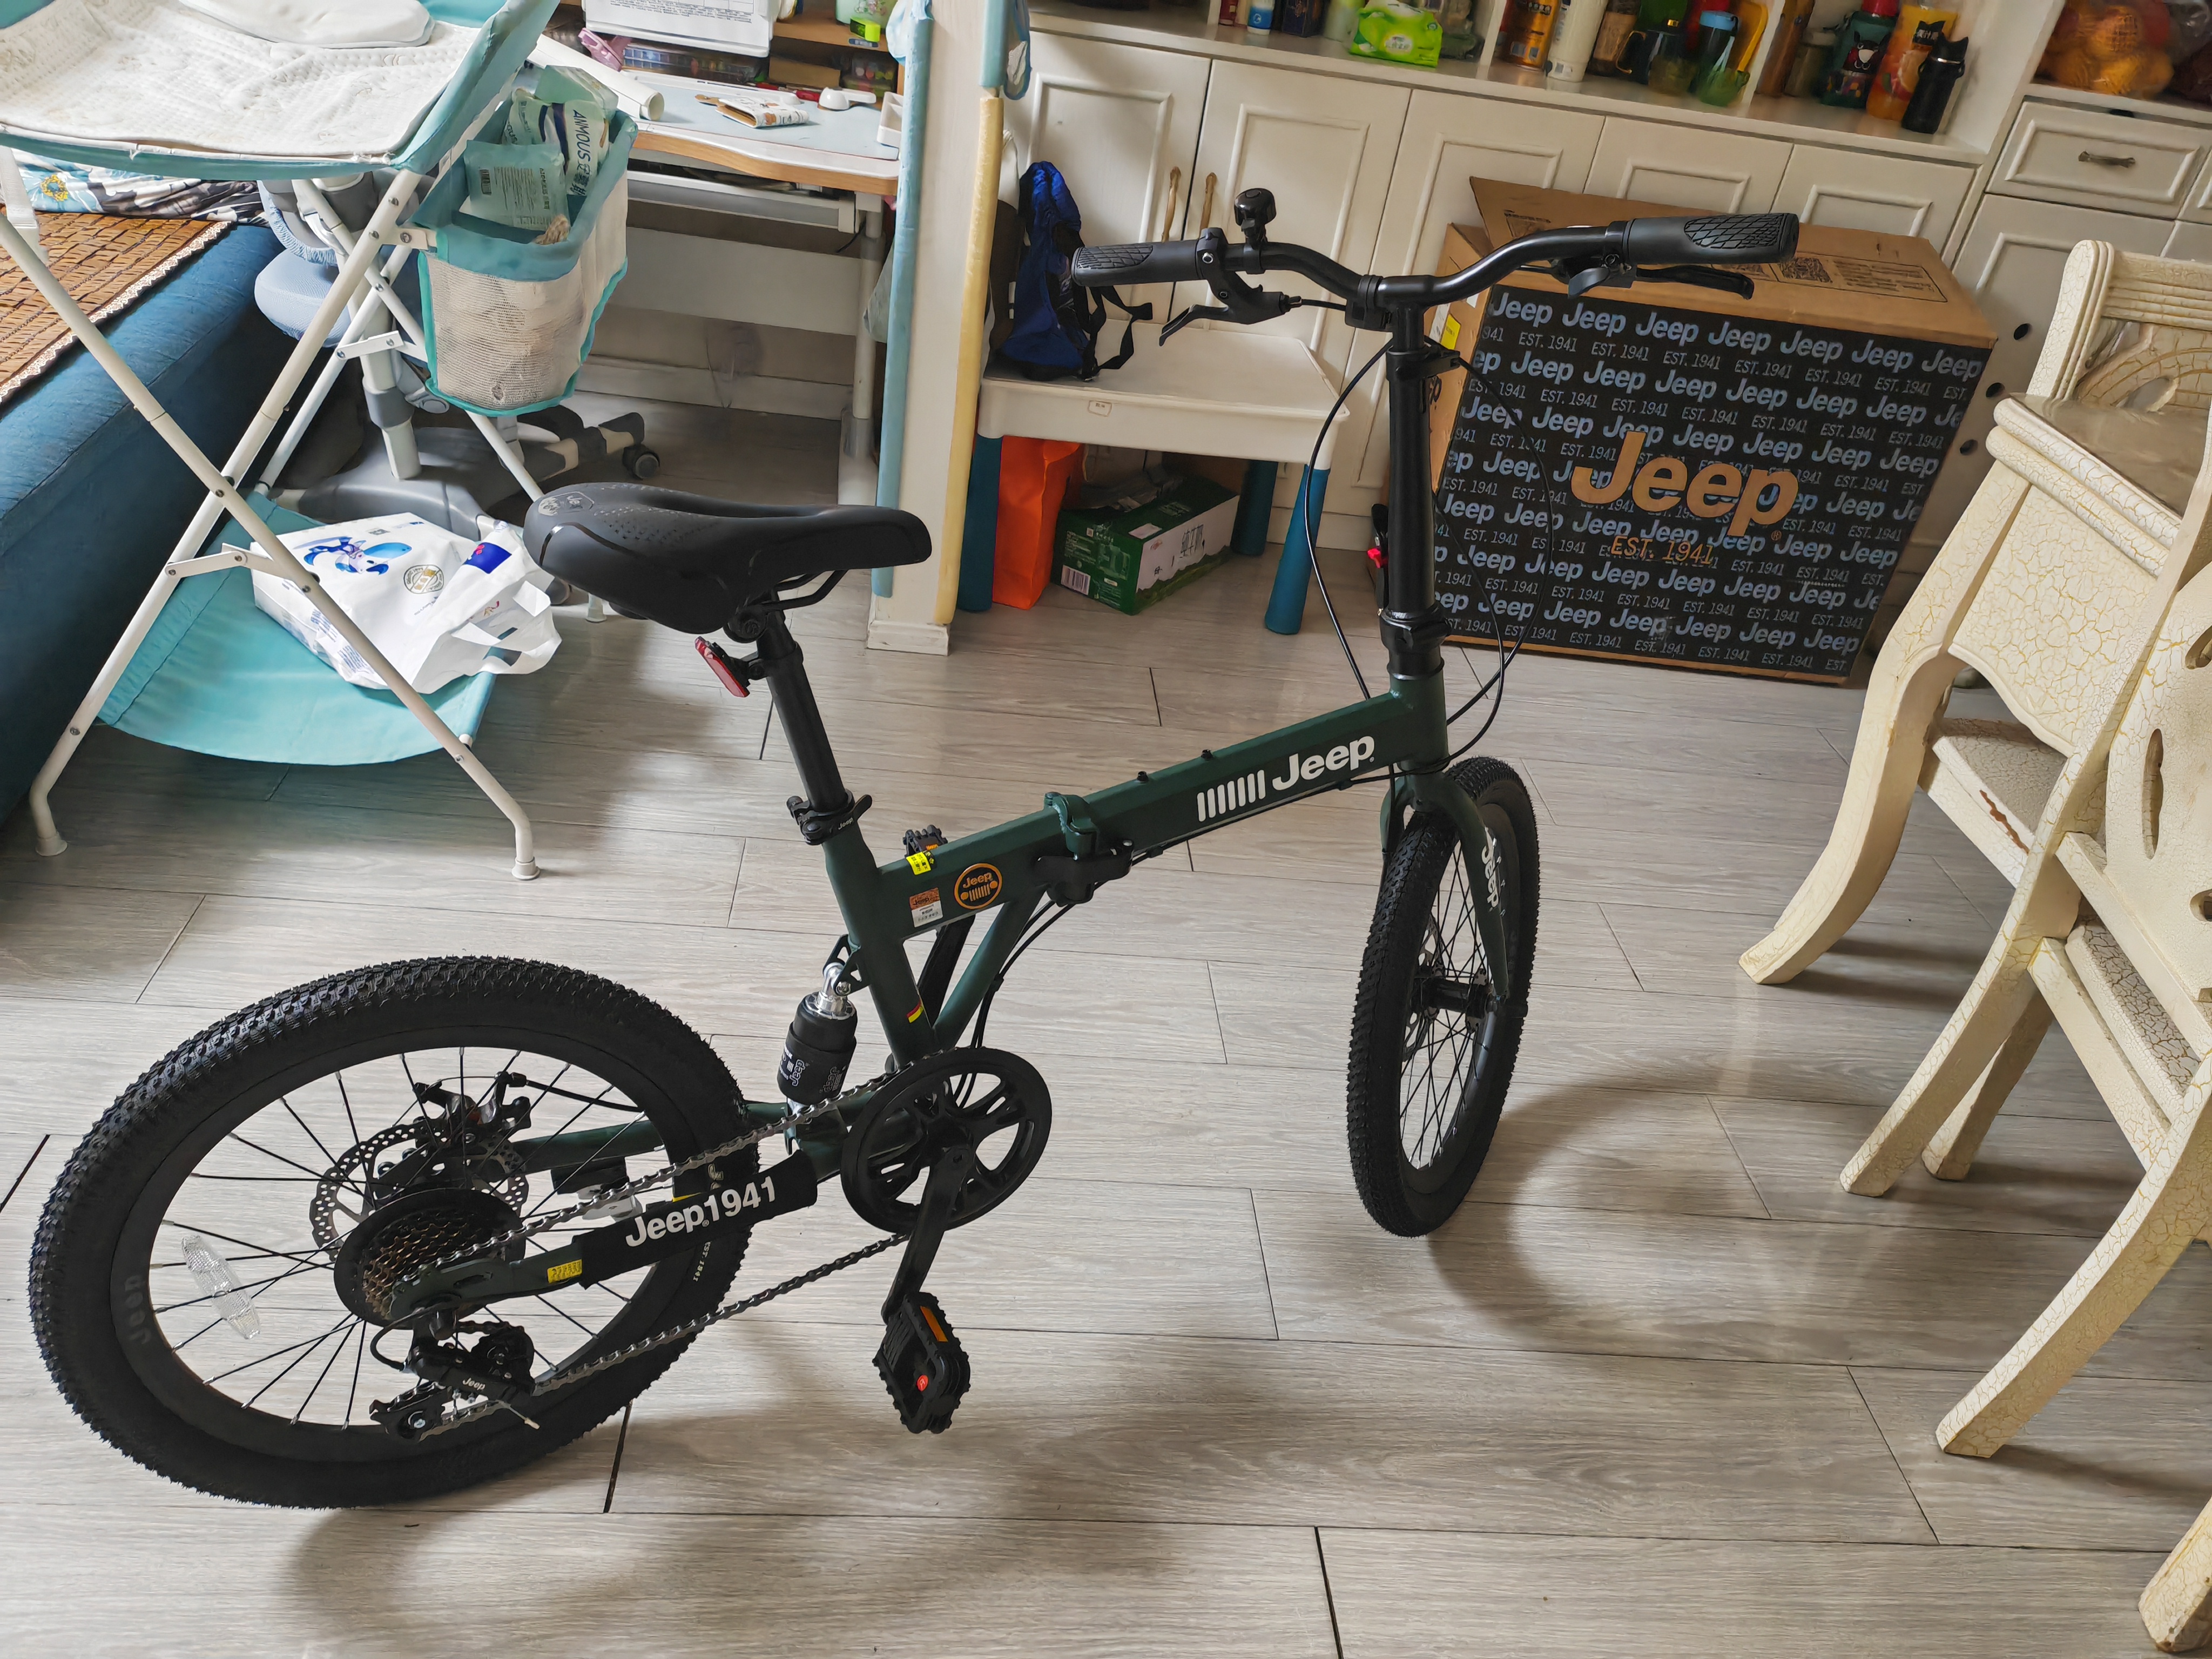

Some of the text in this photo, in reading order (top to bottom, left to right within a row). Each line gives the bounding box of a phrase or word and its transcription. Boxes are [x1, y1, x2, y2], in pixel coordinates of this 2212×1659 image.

[572, 109, 591, 162] ANMOUS
[1482, 327, 1503, 341] 941
[1519, 332, 1544, 347] EST.
[1548, 335, 1577, 352] 1941
[1591, 342, 1616, 358] EST.
[1620, 345, 1649, 361] 1941
[1663, 352, 1688, 366] EST.
[1692, 354, 1721, 370] 1941
[1735, 360, 1759, 374] EST.
[1763, 363, 1792, 379] 1941
[1805, 368, 1829, 382] EST.
[1833, 372, 1862, 387] 1941
[1874, 377, 1899, 392] EST.
[1903, 381, 1931, 396] 1941
[1489, 292, 1982, 381] Jeep Jeep Jeep Jeep Jeep Jeep Jeep
[1473, 350, 1961, 428] ep Jeep Jeep Jeep Jeep Jeep Jeep Je
[1499, 382, 1526, 399] 1941
[1540, 389, 1566, 404] EST.
[1569, 393, 1598, 409] 1941
[1611, 399, 1636, 413] EST.
[1640, 401, 1668, 417] 1941
[1682, 408, 1705, 422] EST.
[1709, 410, 1738, 425] 1941
[1751, 415, 1776, 429] EST.
[1779, 419, 1808, 433] 1941
[1820, 423, 1844, 437] EST.
[1848, 426, 1877, 442] 1941
[1889, 432, 1913, 446] EST.
[1916, 434, 1944, 449] 1941
[1454, 428, 1476, 443] 941
[1490, 433, 1514, 449] EST.
[1518, 436, 1546, 453] 141
[1560, 443, 1584, 458] EST.
[1588, 446, 1616, 461] 1941
[1835, 475, 1860, 488] EST.
[1862, 477, 1890, 492] 1941
[1461, 396, 1523, 429] Jeep
[1532, 407, 1594, 438] Jeep
[1673, 424, 1734, 456] Jeep
[1743, 432, 1803, 463] Jeep
[1811, 440, 1872, 471] Jeep
[1880, 448, 1939, 478] Jeep
[1448, 450, 1473, 473] ep
[1483, 451, 1541, 482] Jeep
[1553, 460, 1612, 489] Jep
[1826, 491, 1885, 521] Jeep
[1893, 500, 1921, 521] Je
[1470, 481, 1499, 496] 1941
[1512, 487, 1535, 501] EST.
[1608, 500, 1635, 513] 1941
[1783, 518, 1805, 531] EST.
[1809, 520, 1837, 535] 1941
[1847, 525, 1872, 538] EST.
[1875, 528, 1903, 542] 1941
[1571, 431, 1799, 537] Jeep
[1444, 493, 1495, 524] Jeep
[1504, 503, 1563, 533] Jeep
[1573, 511, 1631, 538] Jeep
[1641, 520, 1699, 547] Jeep
[1707, 526, 1766, 556] Jeep
[1773, 534, 1832, 561] Jeep
[1840, 541, 1898, 570] Jeep
[1464, 528, 1488, 542] EST.
[1491, 531, 1518, 547] 1941
[1558, 539, 1585, 555] 1941
[1731, 560, 1754, 574] EST.
[1757, 562, 1784, 576] 1941
[1796, 567, 1819, 580] EST.
[1823, 568, 1850, 583] 1941
[1862, 573, 1884, 586] EST.
[1610, 536, 1655, 560] EST.
[1661, 541, 1714, 565] 1941
[1446, 572, 1472, 586] 1941
[1485, 578, 1508, 591] EST.
[1512, 581, 1538, 595] 1941
[1552, 586, 1574, 599] EST.
[1577, 589, 1604, 603] 1941
[1617, 594, 1640, 607] EST.
[1643, 596, 1670, 610] 1941
[1683, 601, 1705, 613] EST.
[1709, 603, 1735, 617] 1941
[1747, 607, 1769, 621] EST.
[1772, 610, 1800, 624] 1941
[1811, 614, 1833, 628] EST.
[1837, 617, 1863, 630] 1941
[1458, 545, 1515, 574] Jeep
[1592, 561, 1650, 590] Jeep
[1658, 569, 1716, 597] Jeep
[1724, 576, 1781, 603] Jeep
[1789, 582, 1846, 610] Jeep
[1854, 589, 1878, 611] Je
[1466, 621, 1492, 633] 1941
[1531, 627, 1557, 642] 1941
[1569, 632, 1592, 645] EST.
[1595, 634, 1621, 648] 1941
[1635, 639, 1657, 653] EST.
[1660, 643, 1686, 656] 1941
[1698, 647, 1720, 660] EST.
[1723, 649, 1749, 662] 1941
[1762, 653, 1784, 665] EST.
[1786, 655, 1813, 668] 1941
[1478, 594, 1535, 621] Jeep
[1544, 601, 1601, 629] Jeep
[1609, 609, 1666, 636] Jeep
[1676, 616, 1732, 643] Jeep
[1739, 622, 1796, 649] Jeep
[1804, 629, 1860, 656] Jeep
[1272, 736, 1375, 791] Jeep
[962, 872, 992, 888] Jeep
[790, 1059, 806, 1086] Jeep
